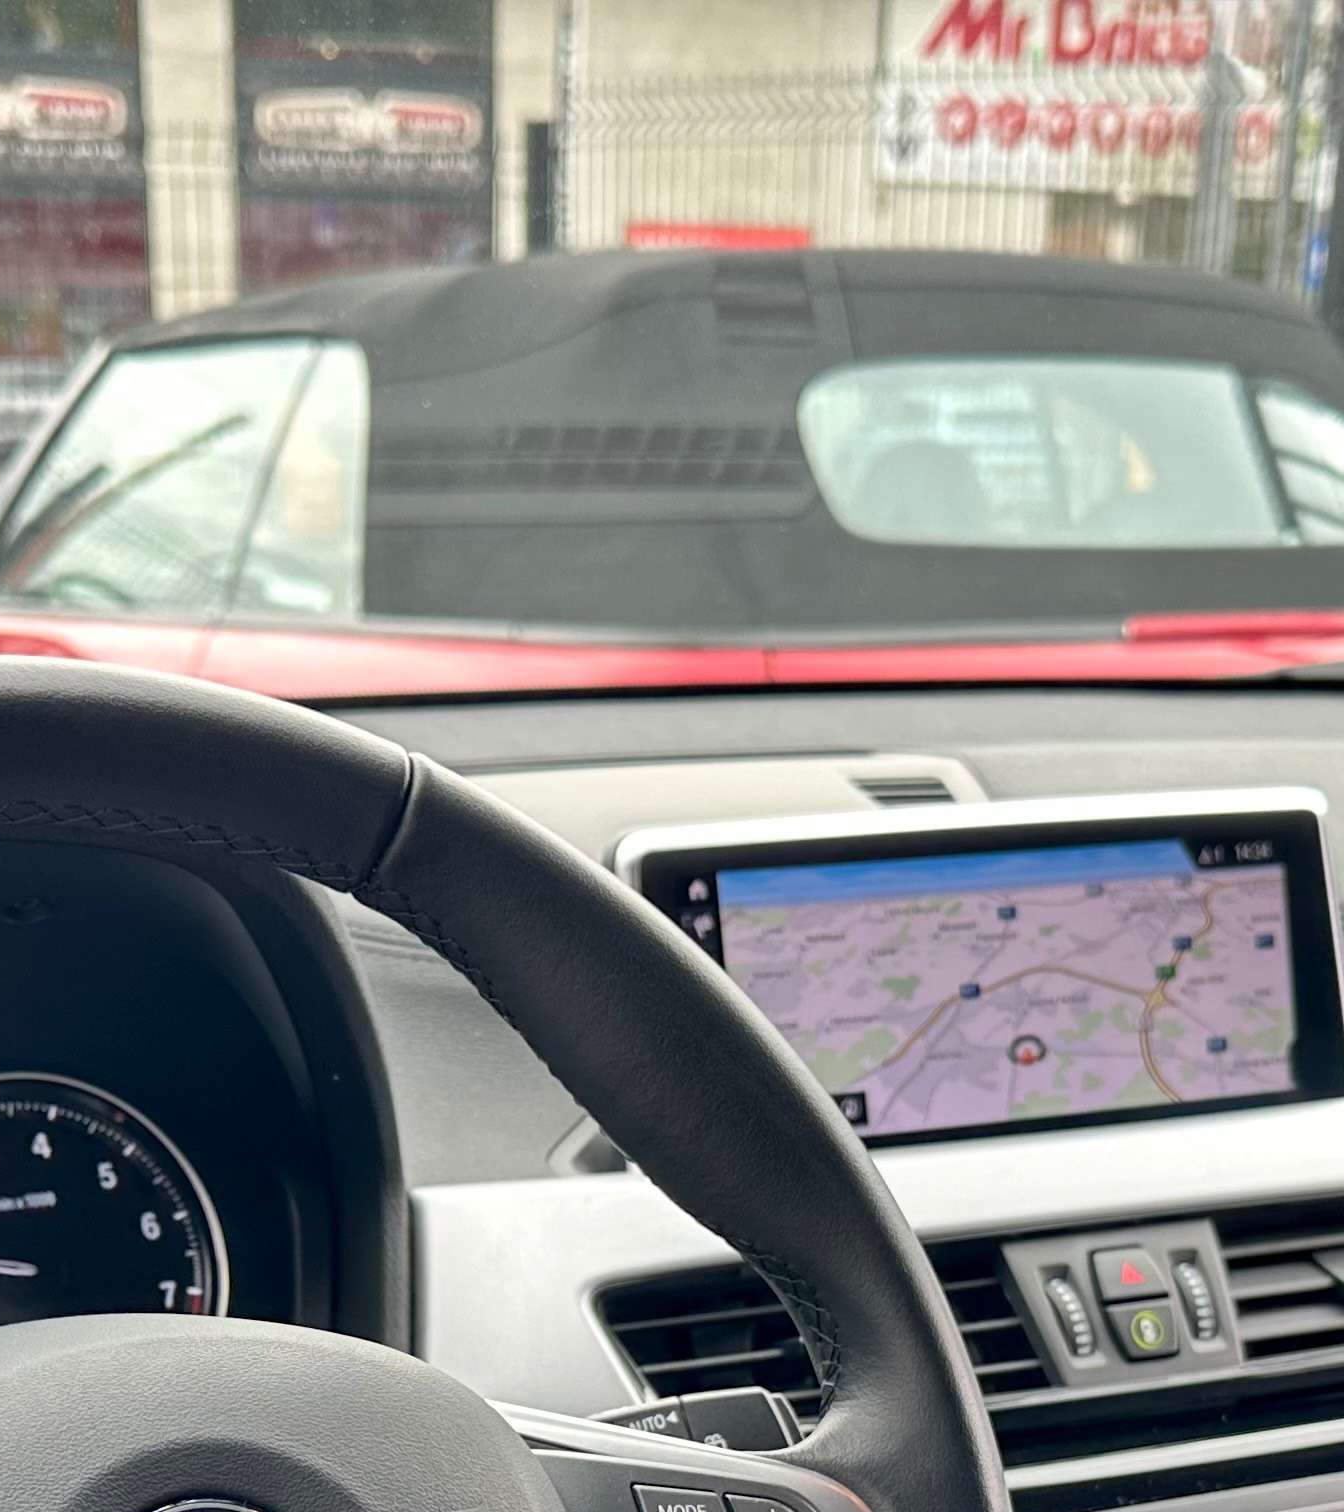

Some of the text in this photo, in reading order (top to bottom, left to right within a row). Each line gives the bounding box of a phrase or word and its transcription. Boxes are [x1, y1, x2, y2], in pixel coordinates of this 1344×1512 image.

[31, 1132, 52, 1159] 4
[96, 1161, 119, 1190] 5
[139, 1211, 162, 1241] 6
[158, 1280, 178, 1309] 7
